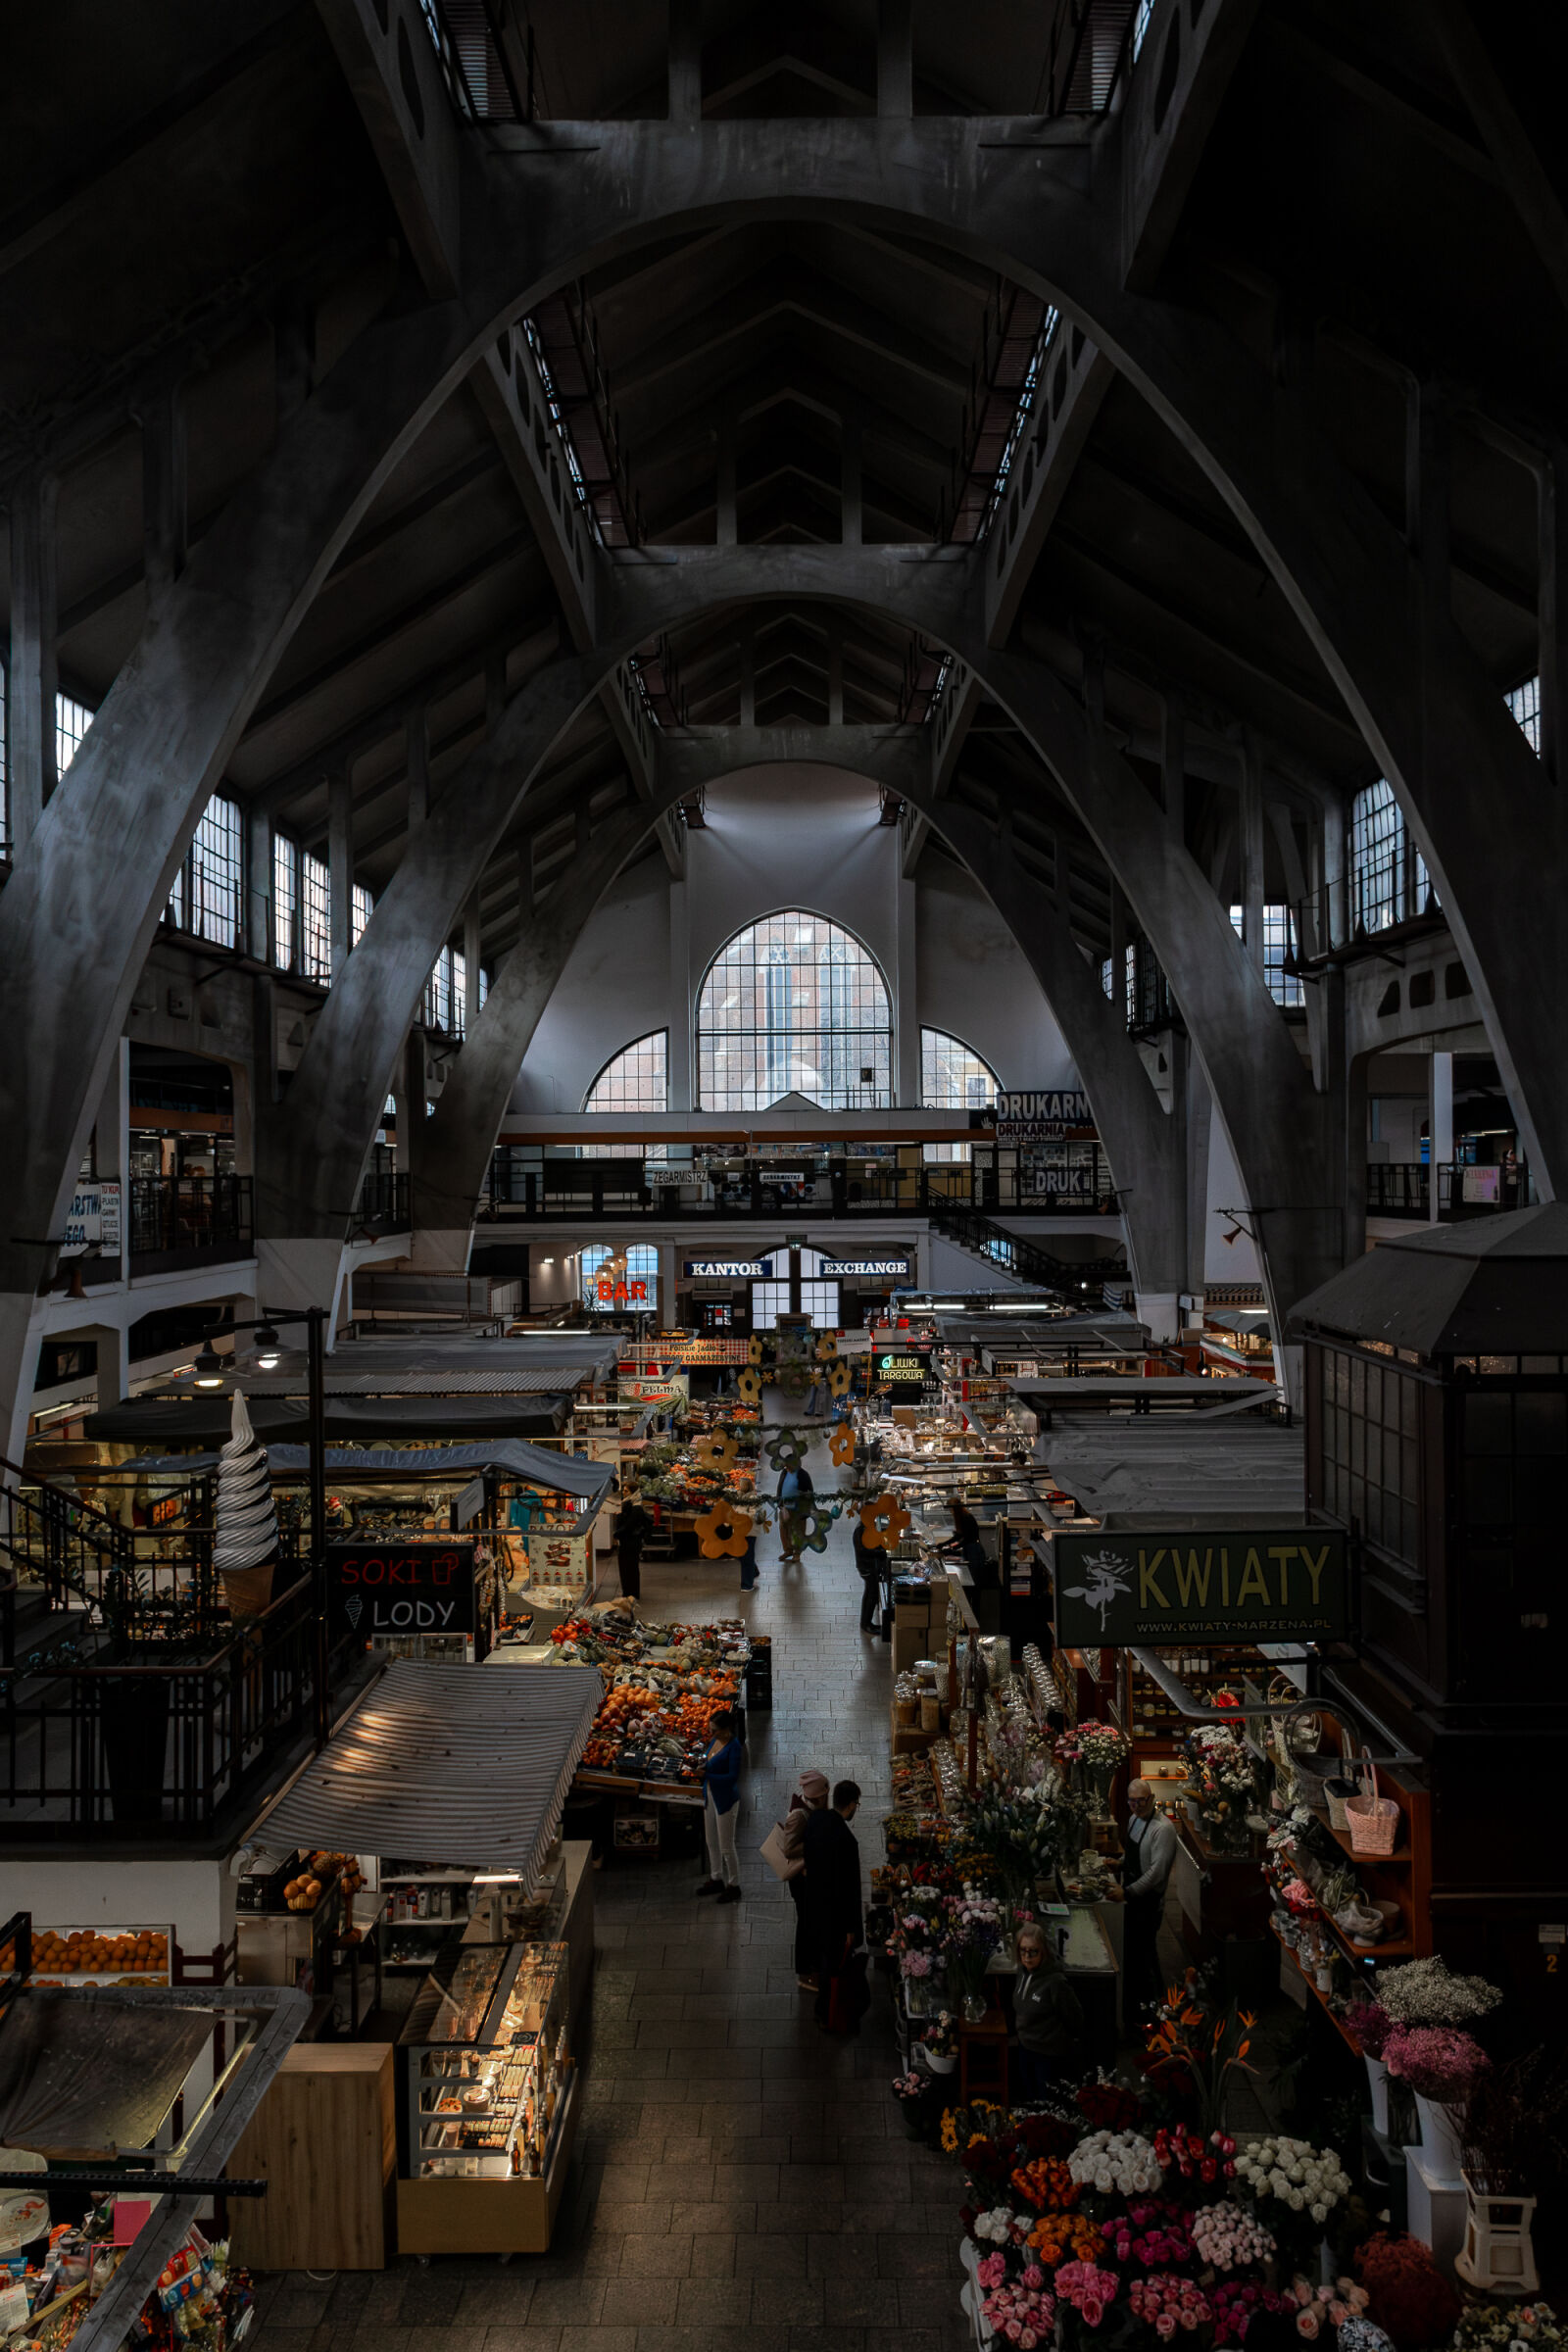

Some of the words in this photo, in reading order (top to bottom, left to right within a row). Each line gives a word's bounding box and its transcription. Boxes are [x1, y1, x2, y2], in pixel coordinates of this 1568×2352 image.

[1000, 1093, 1094, 1120] DRUKARN
[999, 1123, 1065, 1136] DRUKARNIA
[654, 1170, 707, 1184] ZEGARMISTRZ
[1035, 1170, 1081, 1193] DRUK
[691, 1262, 763, 1277] KANTOR
[822, 1261, 907, 1275] EXCHANGE
[598, 1281, 647, 1300] BAR
[882, 1354, 918, 1369] OLIWKI
[876, 1369, 926, 1381] TARGOWA
[340, 1558, 423, 1585] SOKI
[1137, 1544, 1332, 1609] KWIATY
[373, 1600, 456, 1627] LODY
[1136, 1619, 1333, 1634] WWW.KWIATY-MARZENA.PL
[1545, 1953, 1558, 1973] 2
